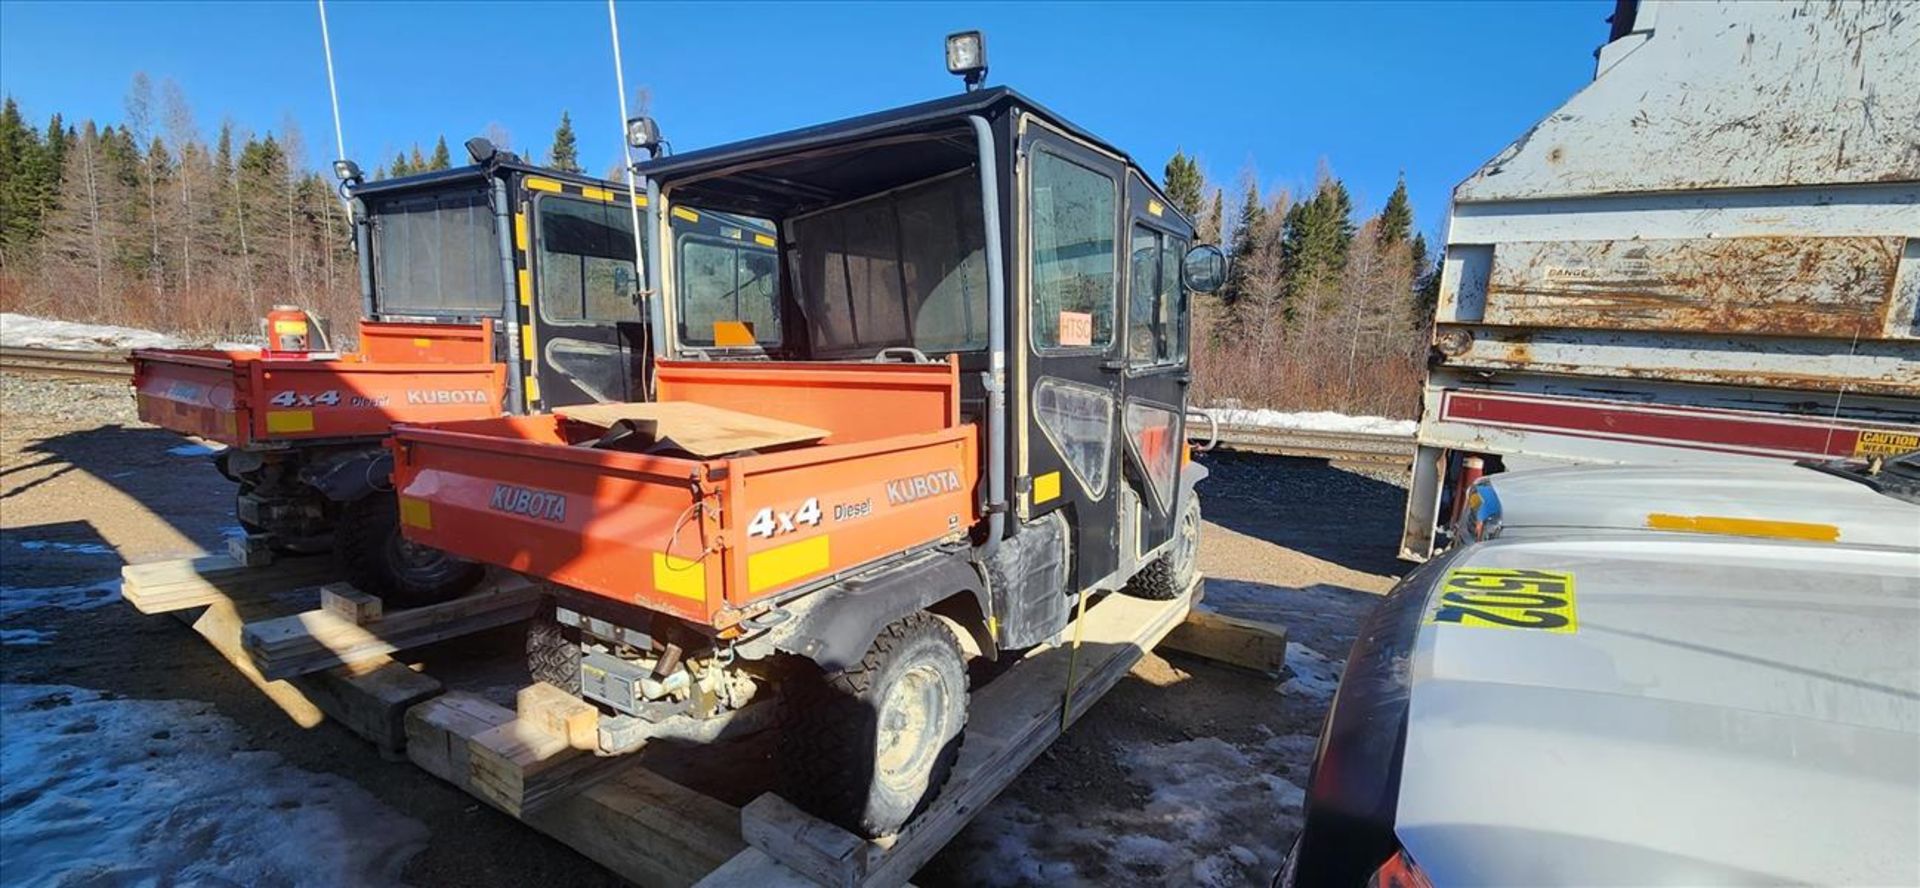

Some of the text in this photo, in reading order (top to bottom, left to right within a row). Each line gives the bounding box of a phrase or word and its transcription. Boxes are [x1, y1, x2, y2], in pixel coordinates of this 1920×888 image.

[1060, 317, 1090, 339] HTSC
[270, 390, 340, 407] 4x4
[407, 389, 488, 404] KUBOTA
[1863, 432, 1918, 446] CAUTION
[490, 484, 565, 522] KUBOTA
[747, 470, 961, 538] 4x4 Diesel KUBOTA
[1434, 569, 1569, 628] 1502
